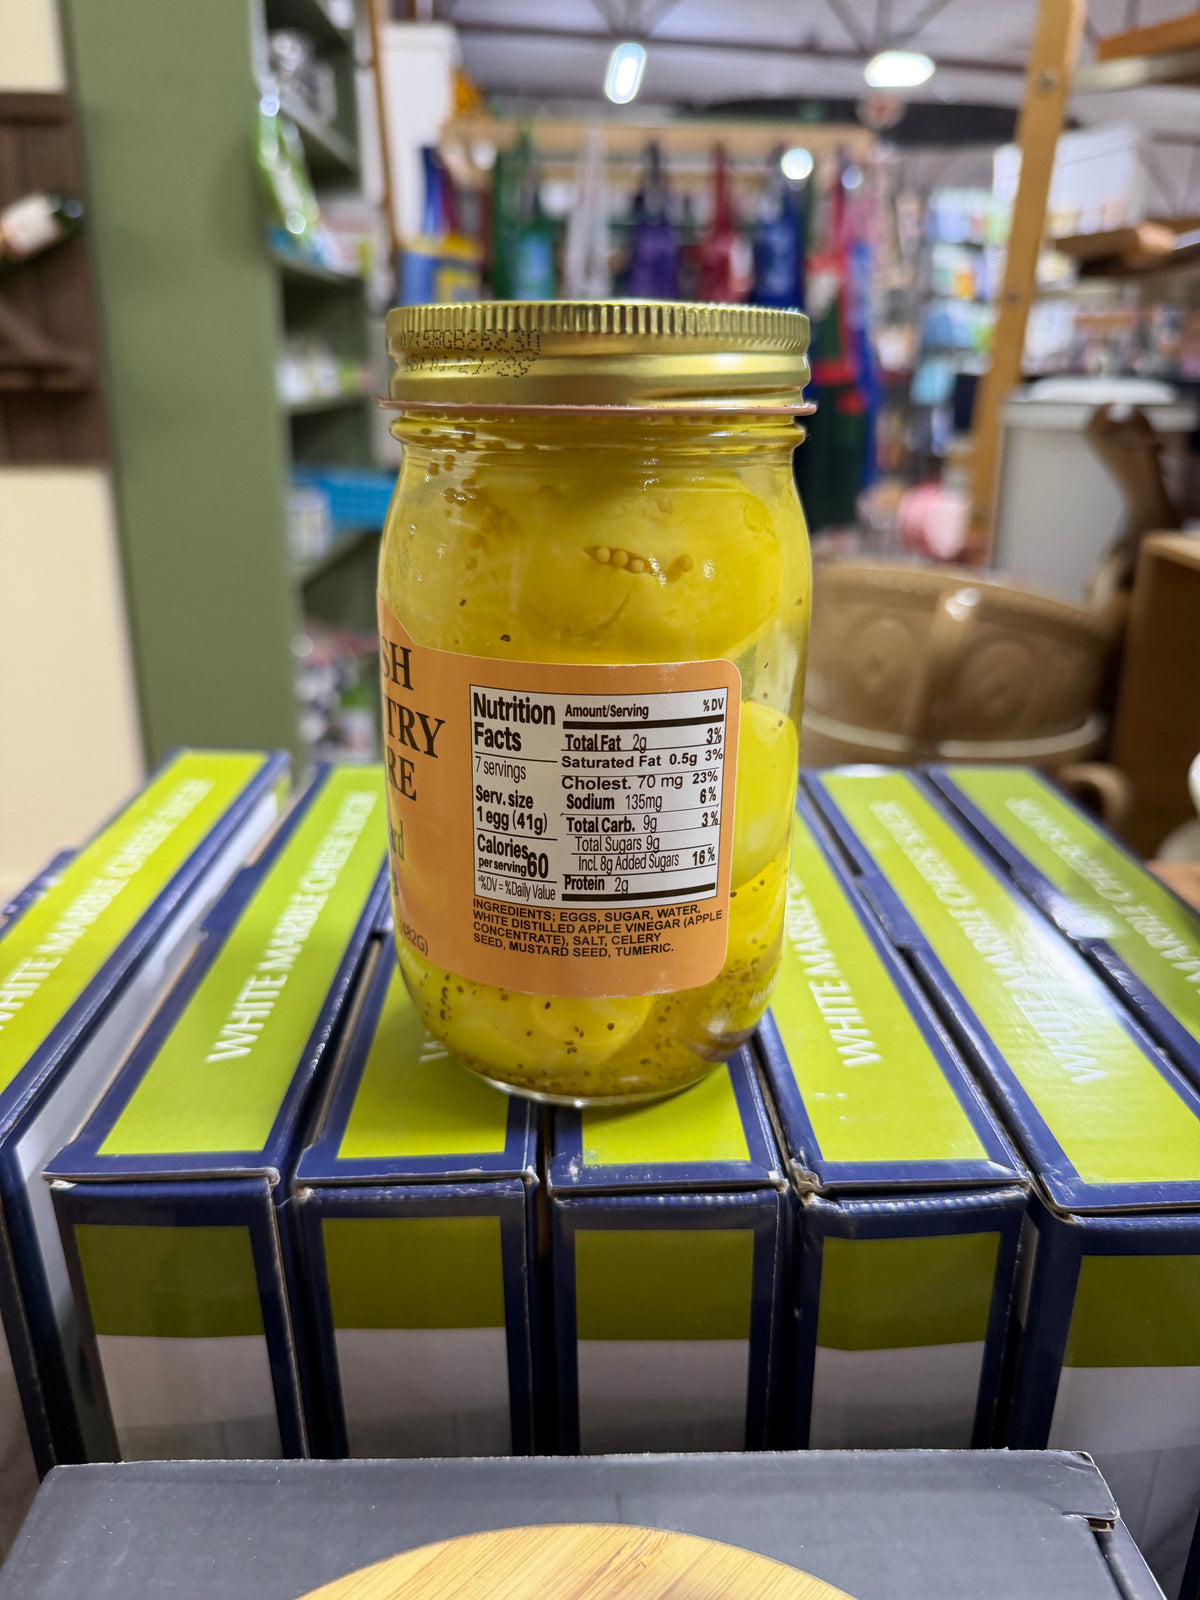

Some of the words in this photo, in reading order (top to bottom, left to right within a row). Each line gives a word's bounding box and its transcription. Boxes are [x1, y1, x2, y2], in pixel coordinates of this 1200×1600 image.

[473, 692, 556, 725] Nutrition
[565, 703, 649, 720] Amount/Serving
[474, 721, 522, 751] Facts
[565, 733, 598, 751] Total
[601, 734, 621, 750] Fat
[632, 733, 647, 753] 2g
[706, 727, 722, 744] 3%
[475, 755, 481, 772] 7
[484, 761, 526, 783] servings
[561, 756, 634, 769] Saturated
[639, 756, 661, 767] Fat
[669, 753, 698, 766] 0.5g
[704, 748, 723, 762] 3%
[561, 776, 632, 790] Cholest.
[637, 775, 656, 789] 70
[661, 776, 683, 789] mg
[692, 770, 718, 785] 23%
[476, 784, 506, 805] Serv.
[508, 790, 534, 809] size
[566, 793, 615, 810] Sodium
[625, 793, 663, 812] 135mg
[477, 806, 483, 822] 1
[486, 811, 509, 831] egg
[512, 809, 548, 835] (41g)
[566, 817, 598, 832] Total
[601, 816, 635, 833] Carb.
[643, 815, 657, 833] 9g
[477, 834, 528, 860] Calories
[527, 852, 549, 879] 60
[575, 836, 602, 851] Total
[605, 836, 642, 853] Sugars
[646, 835, 660, 853] 9g
[479, 857, 493, 869] per
[494, 861, 527, 877] serving
[578, 856, 598, 871] Incl.
[600, 856, 613, 875] 8g
[615, 855, 646, 870] Added
[648, 853, 679, 872] Sugars
[532, 884, 556, 900] Value
[564, 874, 605, 891] Protein
[614, 877, 629, 894] 2g
[473, 909, 509, 927] WHITE
[512, 918, 575, 934] DISTILLED
[578, 924, 622, 934] APPLE
[625, 918, 681, 933] VINEGAR
[683, 909, 723, 928] (APPLE
[560, 912, 601, 923] EGGS,
[604, 910, 654, 922] SUGAR,
[657, 904, 701, 918] WATER,
[473, 921, 569, 947] CONCENTRATE),
[573, 936, 608, 947] SALT,
[611, 932, 661, 945] CELERY
[474, 933, 506, 951] SEED,
[509, 941, 569, 957] MUSTARD
[573, 947, 611, 958] SEED,
[615, 943, 674, 956] TUMERIC.
[948, 907, 1036, 988] MARBLE
[205, 974, 288, 1064] WHITE
[257, 892, 329, 972] MARBLE
[808, 980, 882, 1068] WHITE
[1012, 994, 1107, 1084] WHITE
